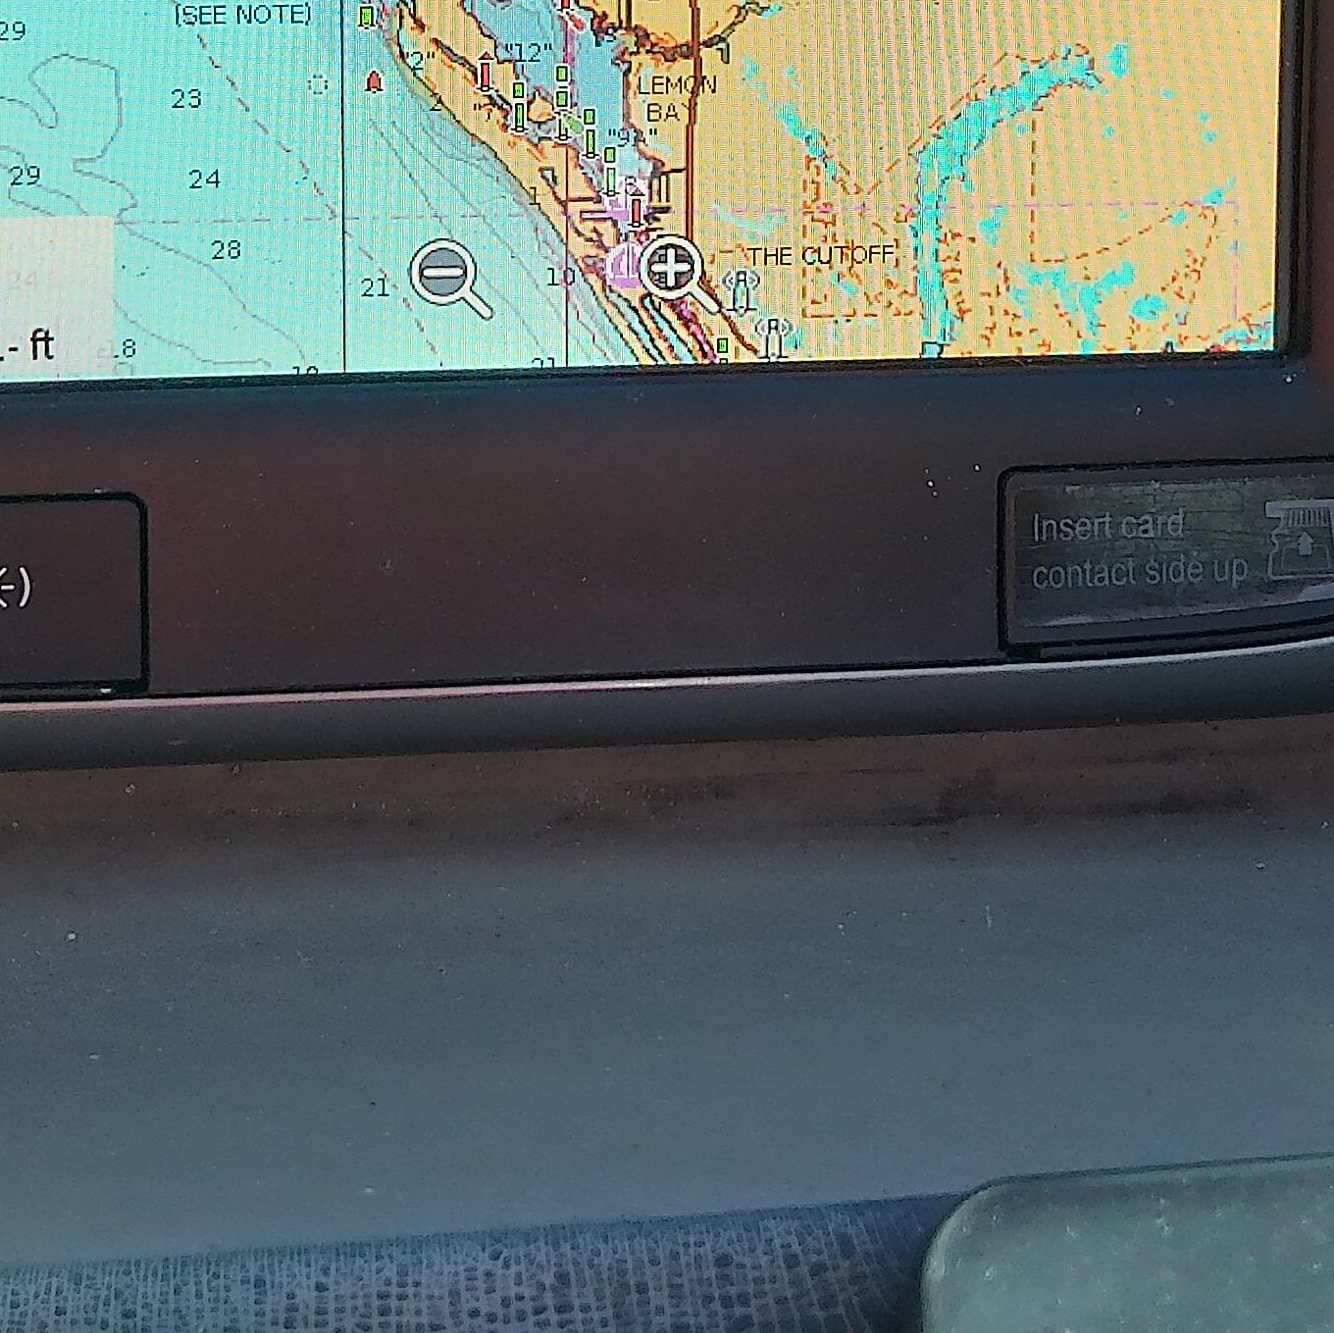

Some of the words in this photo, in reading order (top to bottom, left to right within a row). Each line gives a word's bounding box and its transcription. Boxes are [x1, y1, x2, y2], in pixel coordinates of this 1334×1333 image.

[175, 3, 227, 27] (SEE
[236, 2, 312, 26] NOTE)
[637, 74, 717, 95] LEMON
[170, 88, 202, 110] 23
[8, 166, 41, 188] 29
[188, 169, 221, 191] 24
[210, 239, 242, 260] 28
[751, 246, 792, 266] THE
[802, 245, 895, 266] CUTOFF
[360, 277, 391, 298] 21
[546, 267, 576, 286] 10
[30, 327, 56, 361] ft
[1033, 512, 1113, 542] Insert
[1120, 507, 1186, 539] card
[1032, 556, 1136, 590] contact
[1144, 555, 1204, 585] side
[1212, 555, 1249, 589] up
